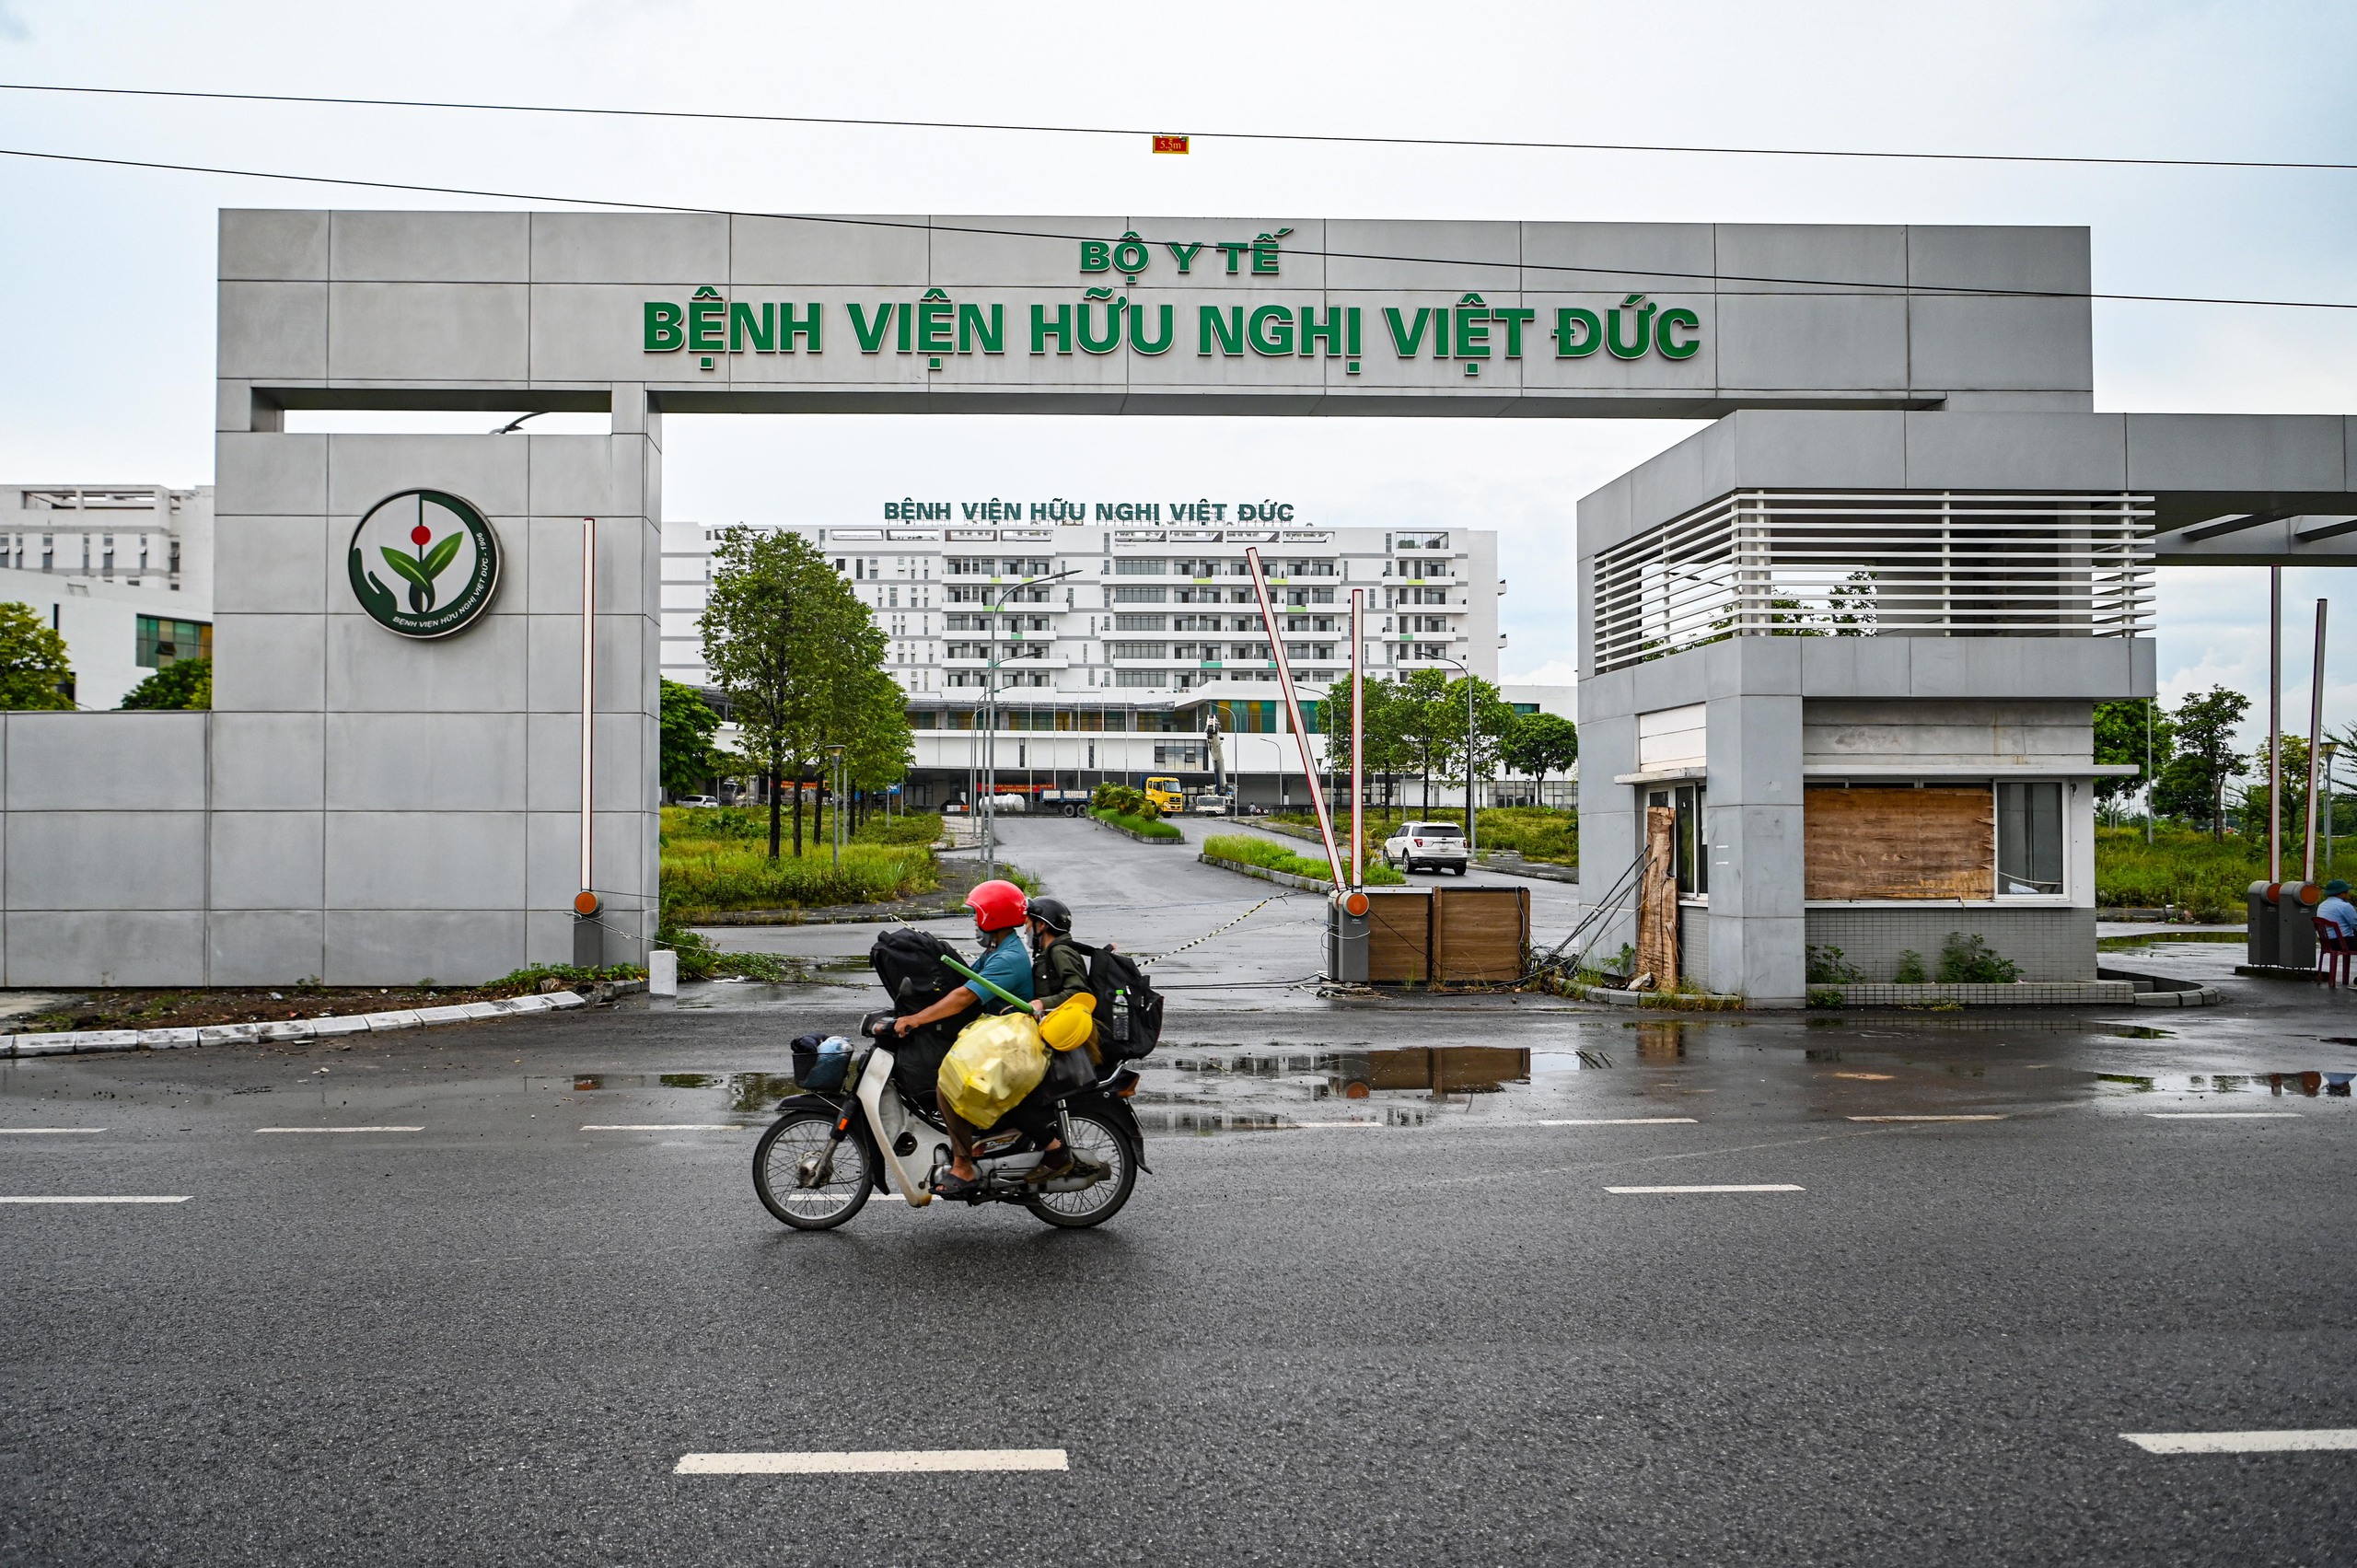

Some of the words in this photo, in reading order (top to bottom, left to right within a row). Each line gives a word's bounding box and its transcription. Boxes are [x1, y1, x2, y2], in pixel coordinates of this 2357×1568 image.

[1080, 231, 1150, 284] BỘ
[1167, 241, 1202, 273] Y
[1216, 227, 1295, 274] TẾ
[643, 285, 823, 370] BỆNH
[844, 286, 1005, 370] VIỆN
[1029, 285, 1175, 355] HỮU
[1197, 304, 1363, 375] NGHỊ
[1382, 292, 1536, 376] VIỆT
[1550, 294, 1700, 360] ĐỨC
[884, 497, 951, 525] BỆNH
[961, 497, 1022, 525] VIỆN
[1030, 498, 1086, 521] HỮU
[1096, 503, 1160, 526] NGHỊ
[1169, 498, 1228, 526] VIỆT
[1237, 499, 1295, 521] ĐỨC
